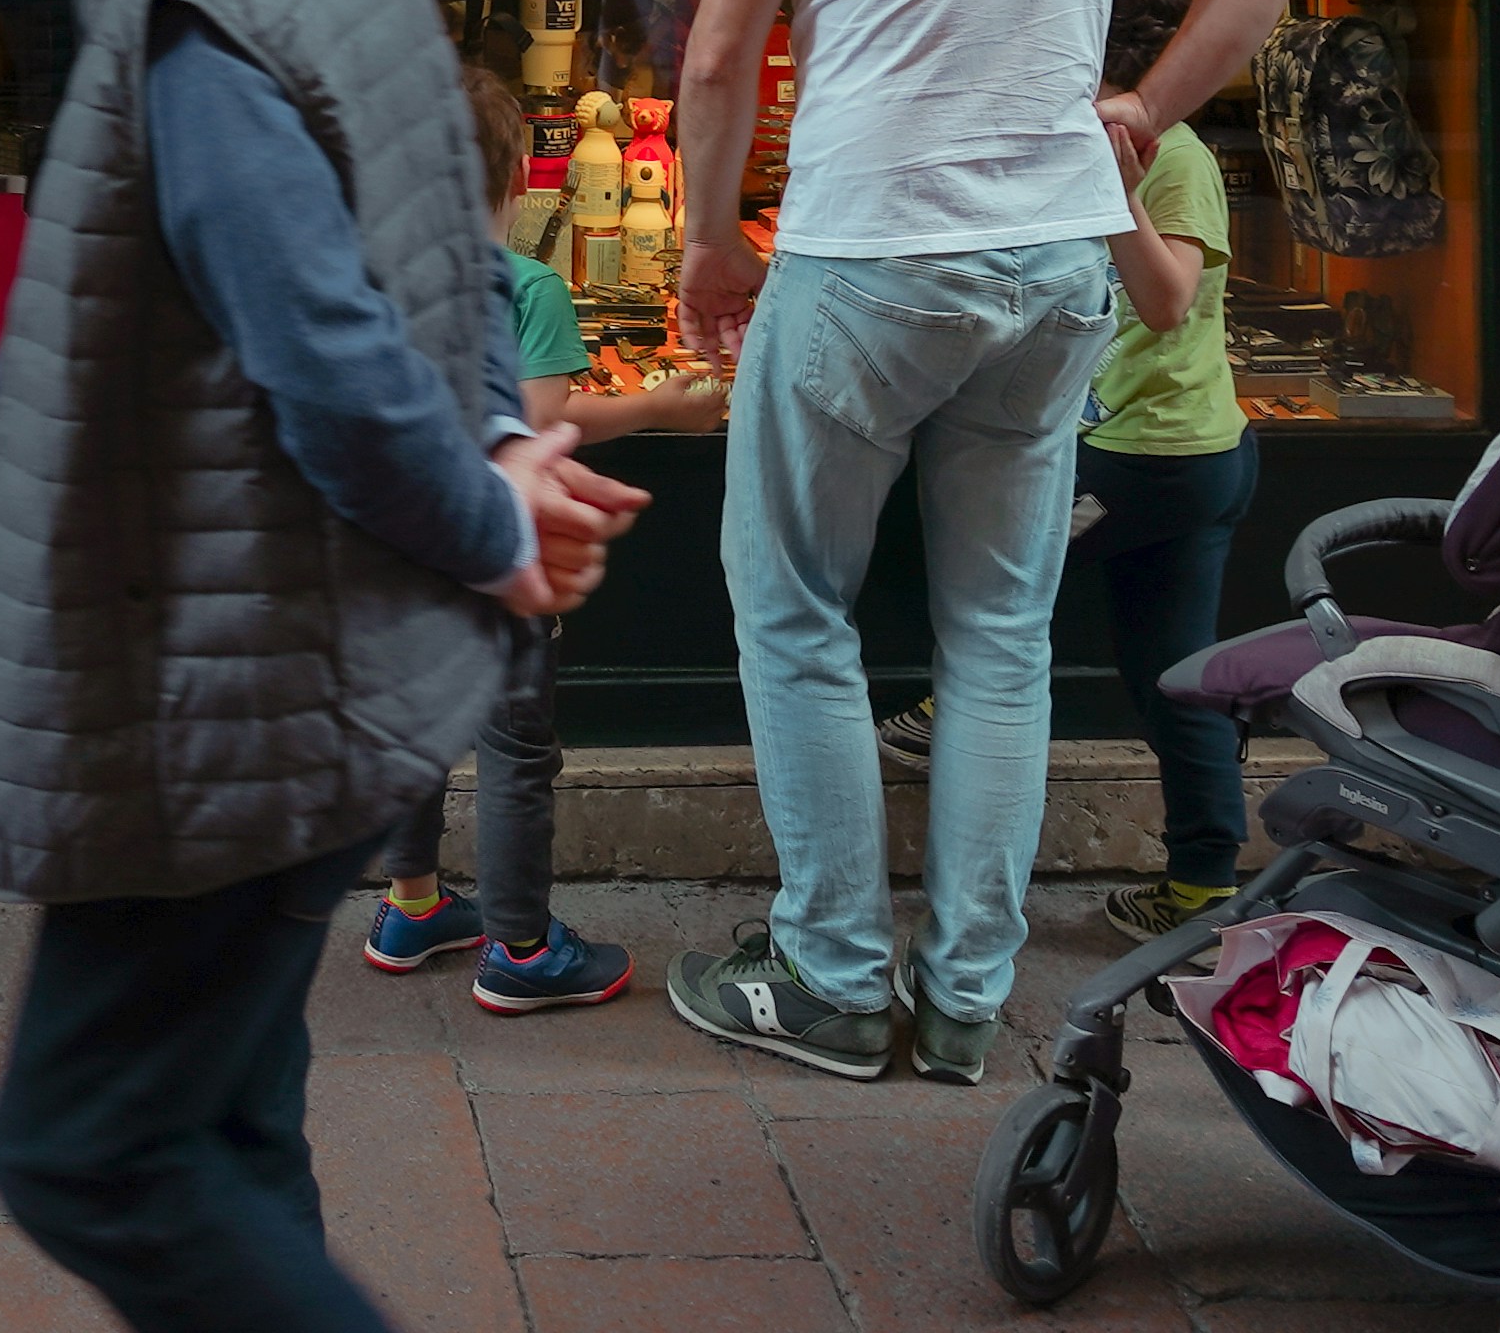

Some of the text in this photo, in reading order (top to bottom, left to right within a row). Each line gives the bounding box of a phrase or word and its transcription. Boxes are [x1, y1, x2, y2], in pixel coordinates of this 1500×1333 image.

[555, 0, 576, 14] YET
[553, 69, 570, 80] YET
[1339, 782, 1389, 815] Inglesina
